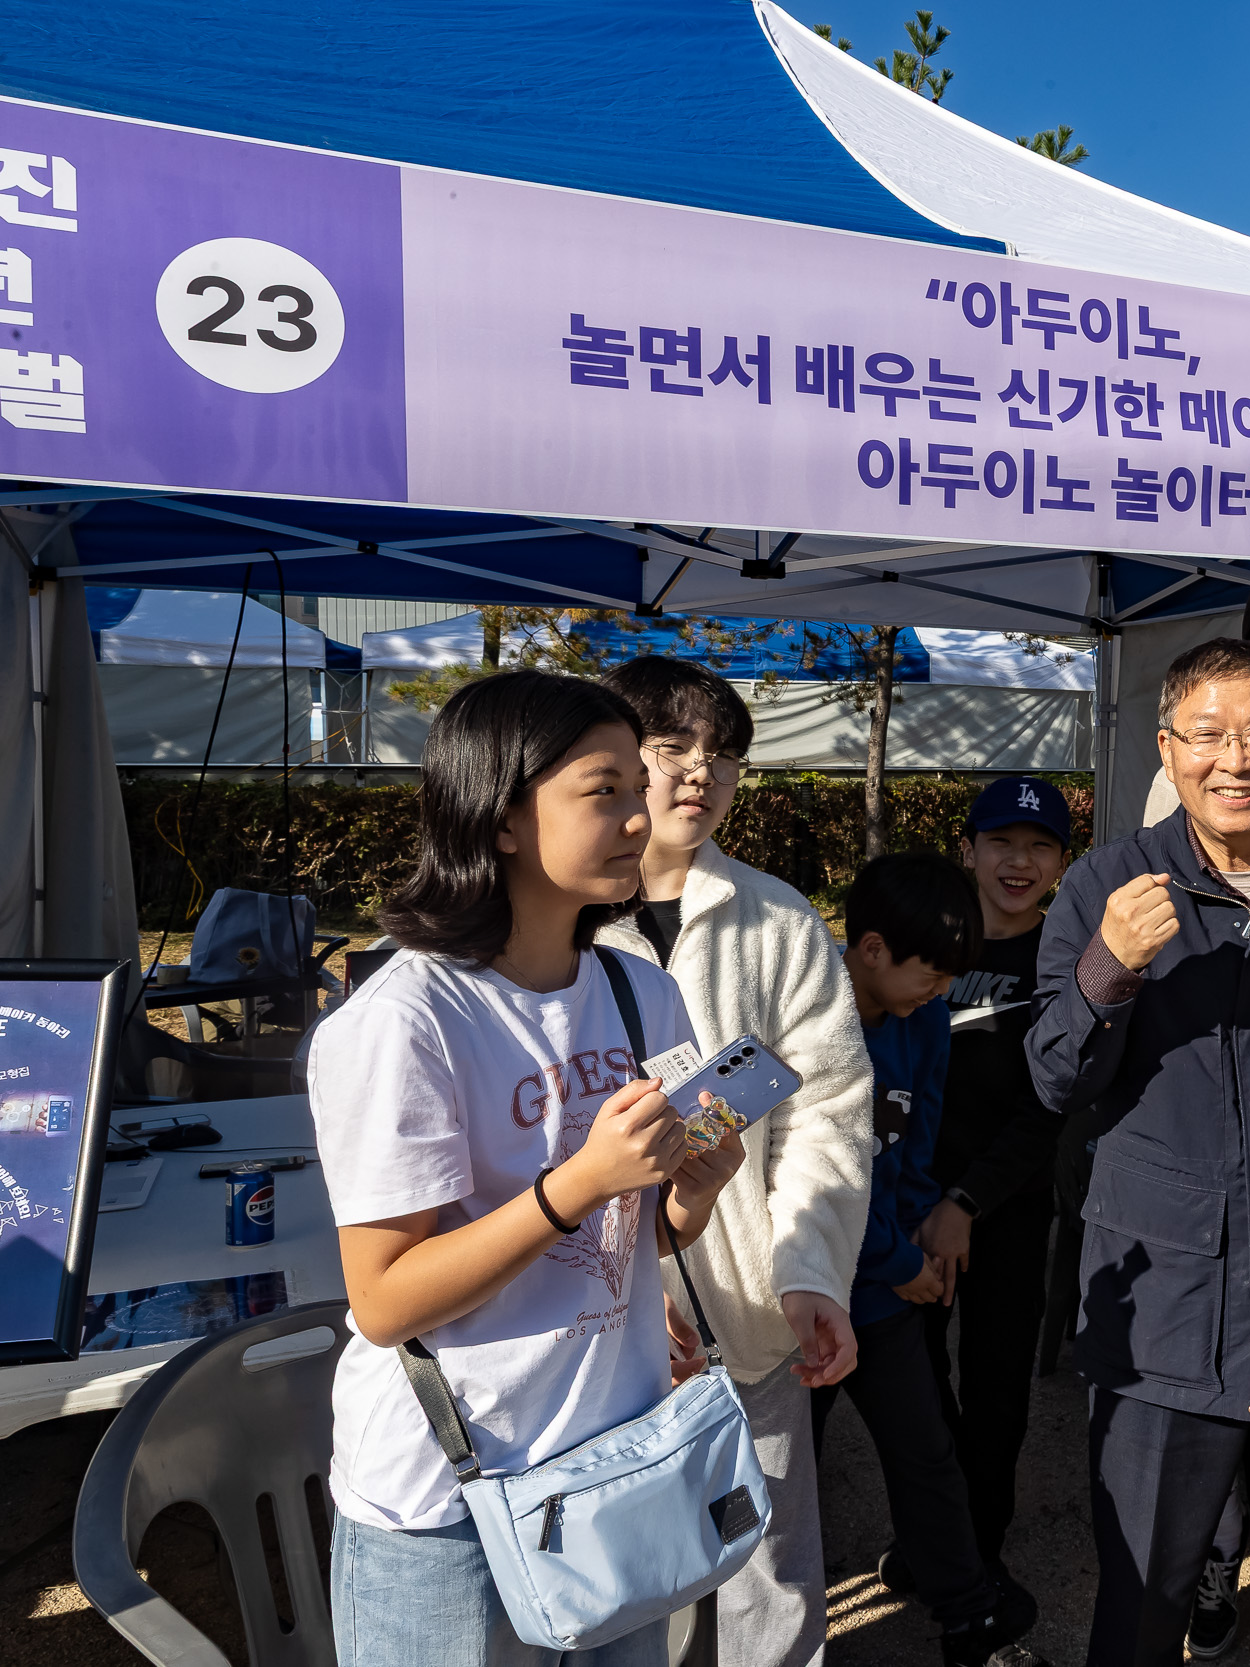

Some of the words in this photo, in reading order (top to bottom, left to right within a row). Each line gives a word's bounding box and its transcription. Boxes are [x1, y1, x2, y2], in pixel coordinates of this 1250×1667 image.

[186, 275, 318, 353] 23
[562, 313, 771, 405] 놀면서
[795, 343, 981, 423] 배우는
[998, 369, 1164, 441] 신기한
[857, 437, 1095, 515] 아두이노
[1017, 784, 1040, 811] LA
[941, 970, 1020, 1007] NIKE
[36, 1016, 71, 1039] 동아리
[555, 1325, 586, 1343] LOS
[576, 1311, 601, 1325] Guess
